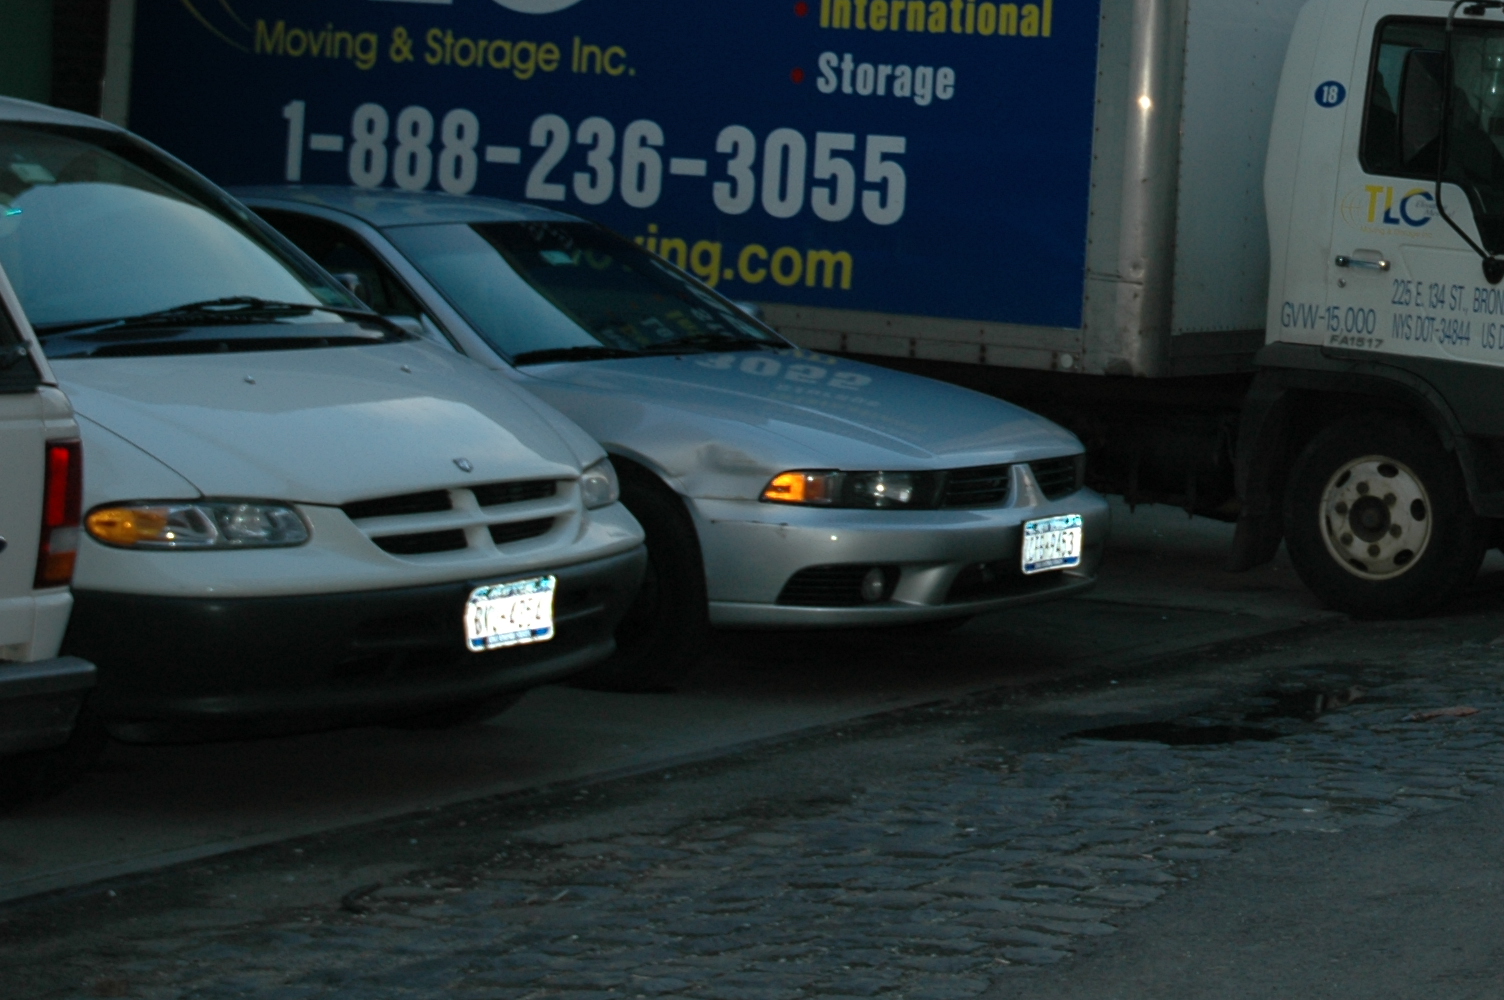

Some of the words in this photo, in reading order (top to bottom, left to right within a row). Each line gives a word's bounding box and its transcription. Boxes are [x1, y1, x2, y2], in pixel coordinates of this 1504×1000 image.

[256, 19, 379, 70] Moving
[390, 26, 414, 62] &
[425, 28, 560, 80] Storage
[572, 37, 637, 75] Inc.
[816, 51, 956, 106] Storage
[1323, 85, 1338, 103] 18
[283, 99, 907, 226] 1-888-236-3055
[1365, 185, 1434, 227] TLC
[634, 223, 854, 290] ing.com
[1392, 278, 1412, 307] 225
[1429, 283, 1445, 309] 134
[1281, 301, 1376, 336] GVW-15,000
[1392, 313, 1413, 342] NYS
[1481, 322, 1497, 349] US
